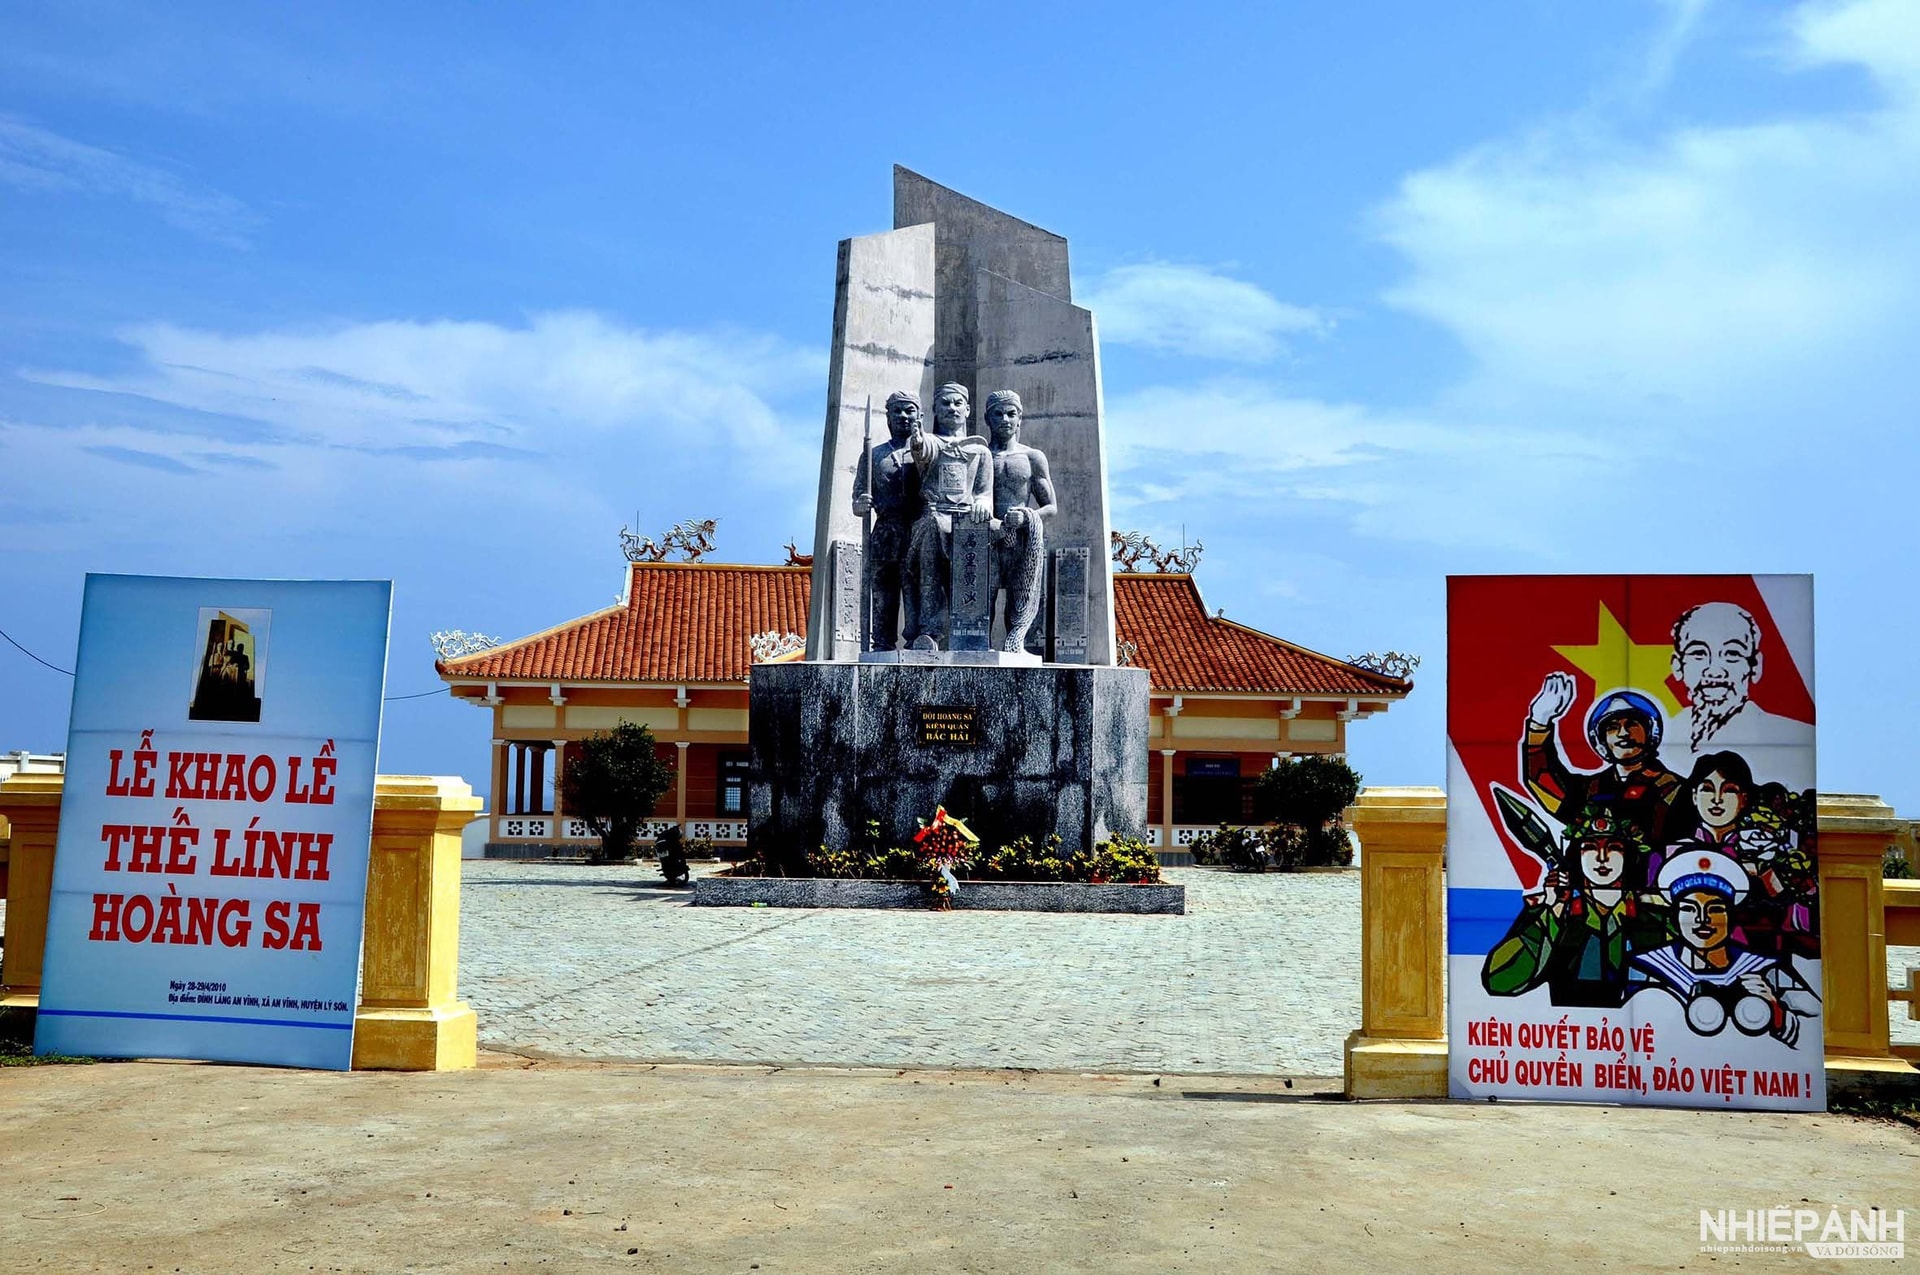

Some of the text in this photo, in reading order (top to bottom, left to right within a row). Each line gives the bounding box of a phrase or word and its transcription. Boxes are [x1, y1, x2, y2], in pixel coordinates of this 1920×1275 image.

[950, 731, 969, 741] HẢI
[106, 729, 337, 805] LỄ KHAO LỀ
[101, 807, 334, 881] THẾ LÍNH
[88, 883, 323, 952] HOÀNG SA
[170, 980, 227, 992] Ngày 28-29/4/2010
[232, 995, 241, 1006] AN
[271, 998, 281, 1008] AN
[324, 999, 332, 1010] LÝ
[1468, 1014, 1655, 1060] KIÊN QUYẾT BẢO VỆ
[1468, 1050, 1811, 1102] CHỦ QUYỀN BIỂN, ĐẢO VIỆT NAM !
